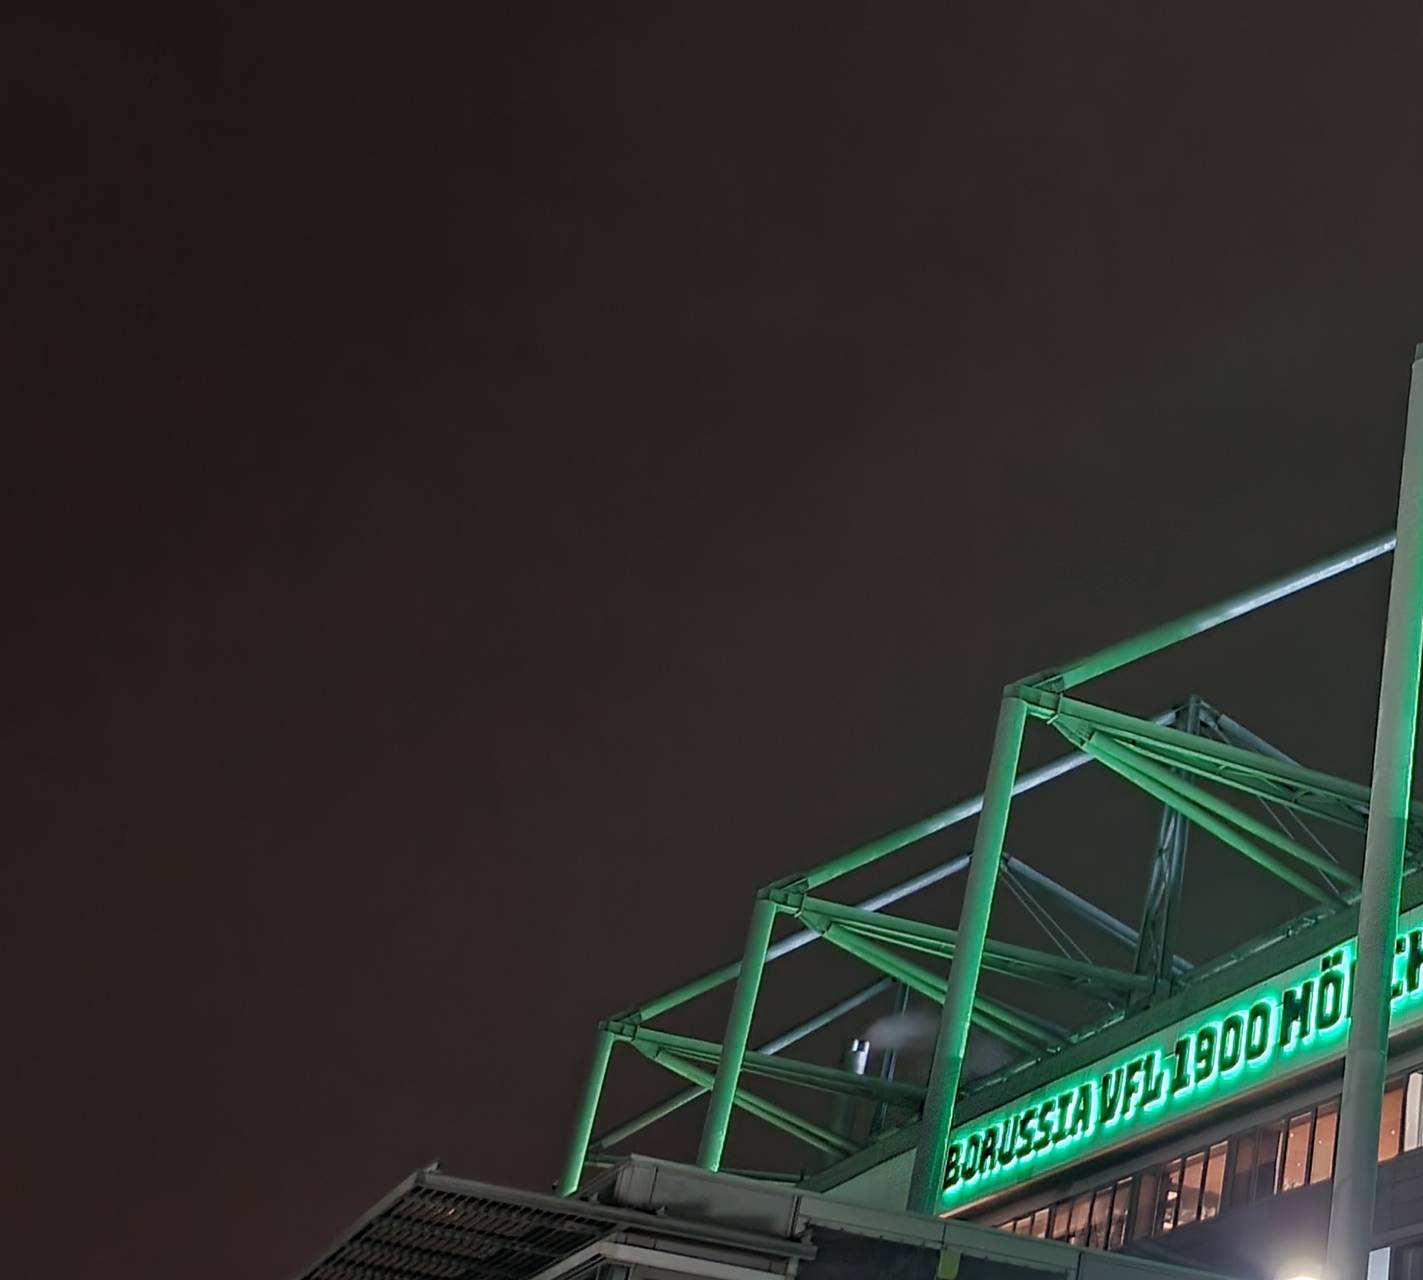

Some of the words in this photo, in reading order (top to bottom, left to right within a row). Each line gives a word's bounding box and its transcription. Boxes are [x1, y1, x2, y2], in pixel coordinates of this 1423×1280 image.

[944, 1084, 1095, 1190] BORUSSIA
[1101, 1051, 1164, 1125] VFL
[1171, 1001, 1270, 1096] 1900
